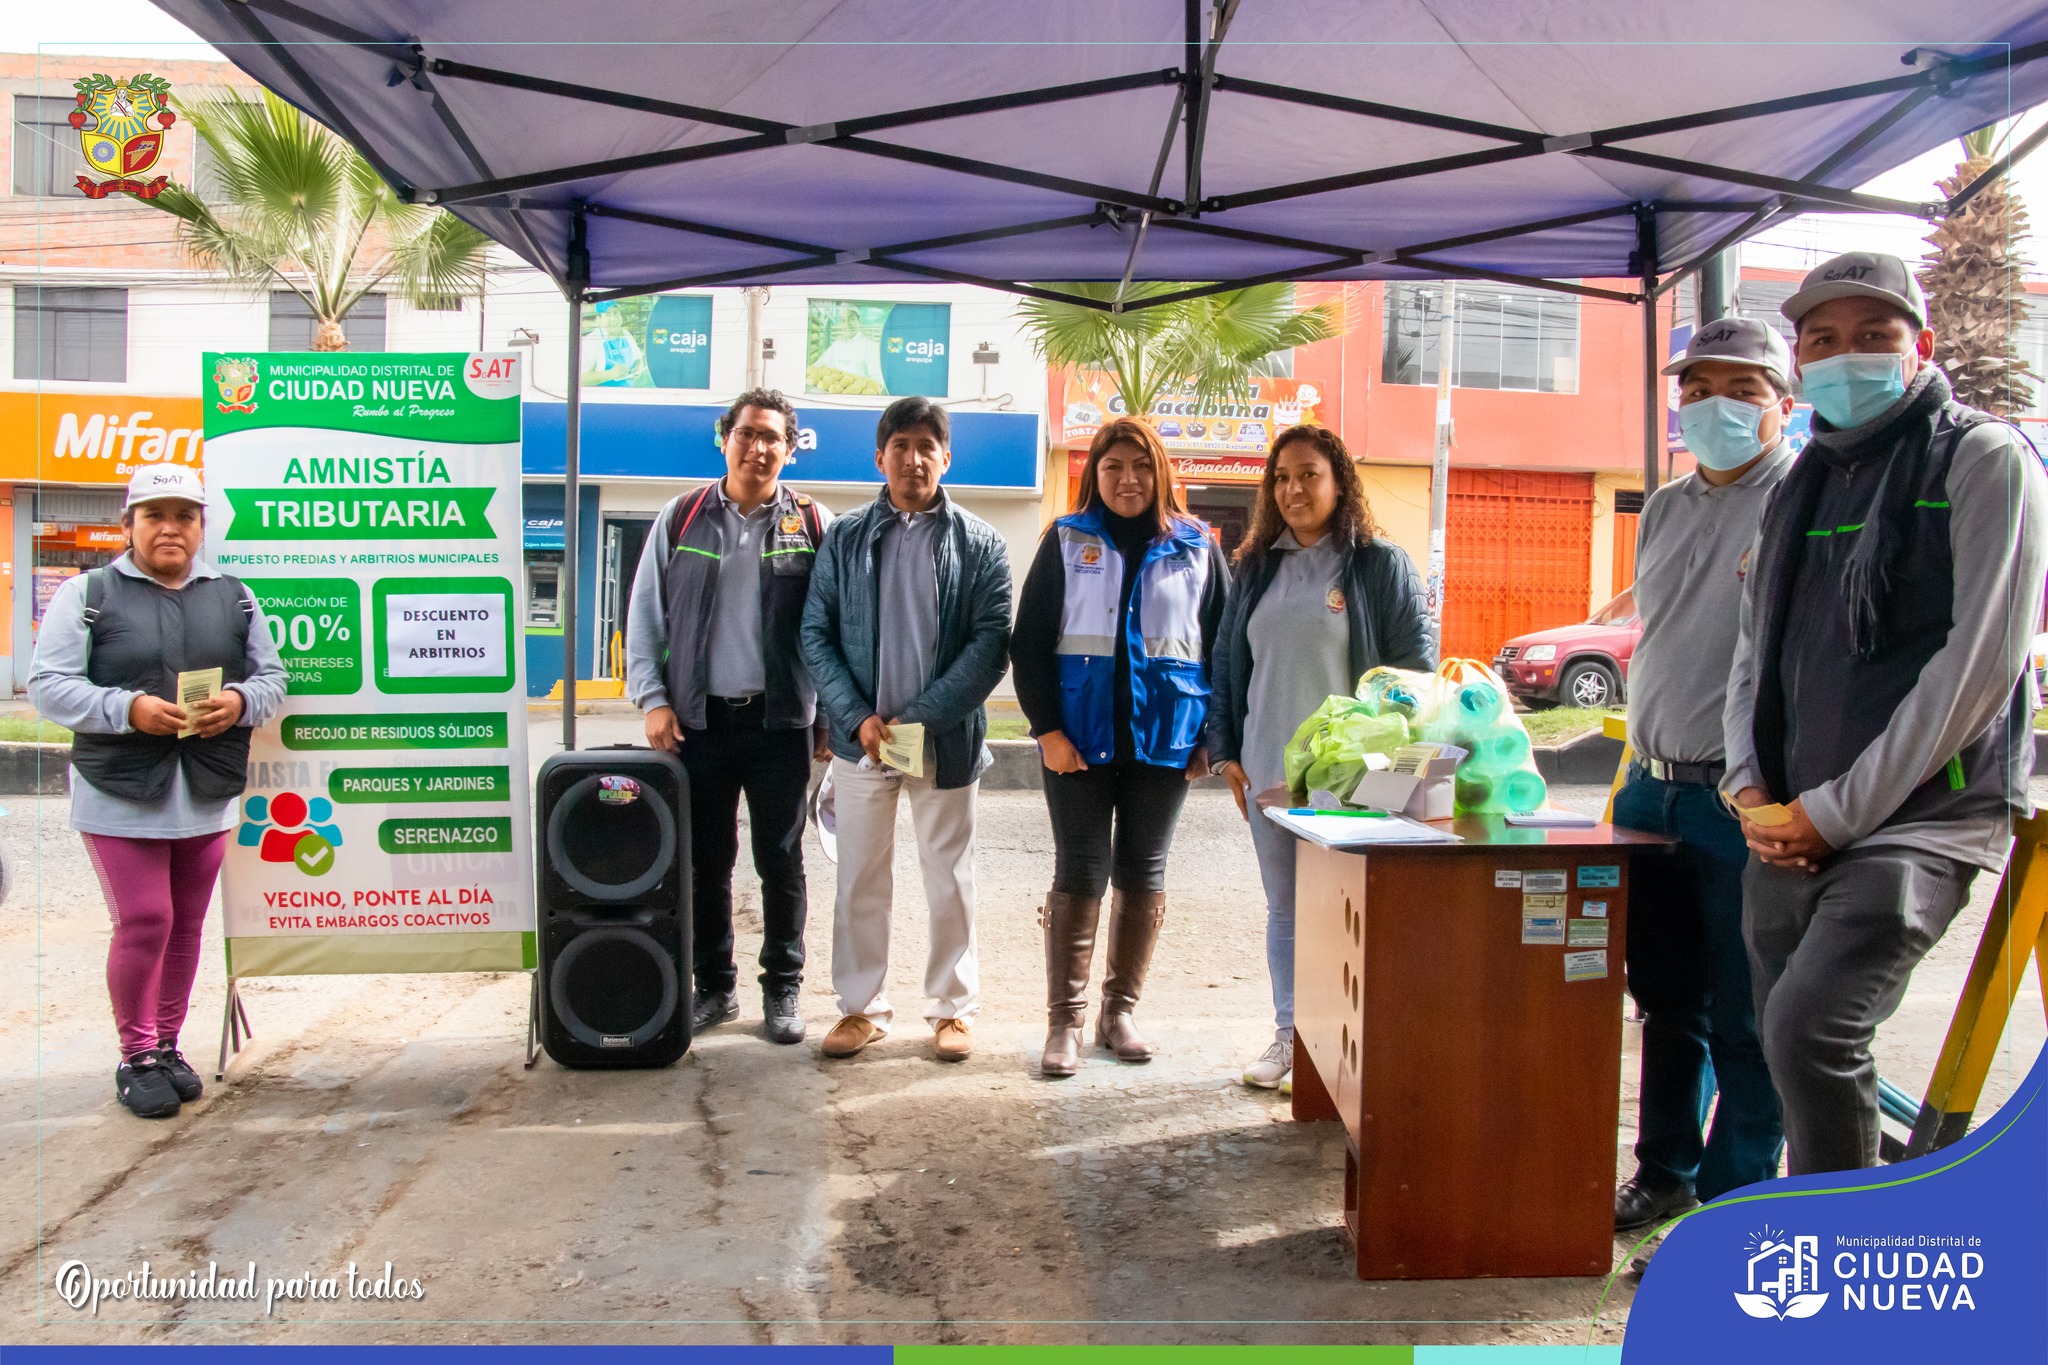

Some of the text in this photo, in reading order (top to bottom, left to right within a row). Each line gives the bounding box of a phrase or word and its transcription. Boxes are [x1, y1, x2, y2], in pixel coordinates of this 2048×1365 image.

[670, 330, 707, 348] caja
[905, 338, 945, 357] caja
[269, 365, 455, 376] MUNICIPALIDAD DISTRITAL DE
[268, 380, 457, 400] CIUDAD NUEVA
[352, 404, 455, 419] Rumbo al Progreso
[1065, 427, 1098, 438] TORTA
[283, 450, 451, 484] AMNISTÍA
[153, 474, 184, 485] SgAT
[255, 500, 466, 528] TRIBUTARIA
[527, 518, 564, 527] caja
[90, 531, 125, 542] Mifarm
[218, 553, 499, 565] IMPUESTO PREDIAS Y ARBITRIOS MUNICIPALES
[256, 595, 348, 608] DONACIÓN DE
[403, 609, 489, 621] DESCUENTO
[265, 614, 351, 651] 00%
[437, 629, 456, 641] EN
[408, 647, 486, 659] ARBITRIOS
[288, 672, 323, 683] ORAS
[294, 722, 494, 740] RECOJO DE RESIDUOS SÓLIDOS
[343, 776, 495, 792] PARQUES Y JARDINES
[394, 826, 498, 845] SERENAZGO
[263, 883, 494, 910] VECINO, PONTE AL DÍA
[269, 913, 490, 929] EVITA EMBARGOS COACTIVOS
